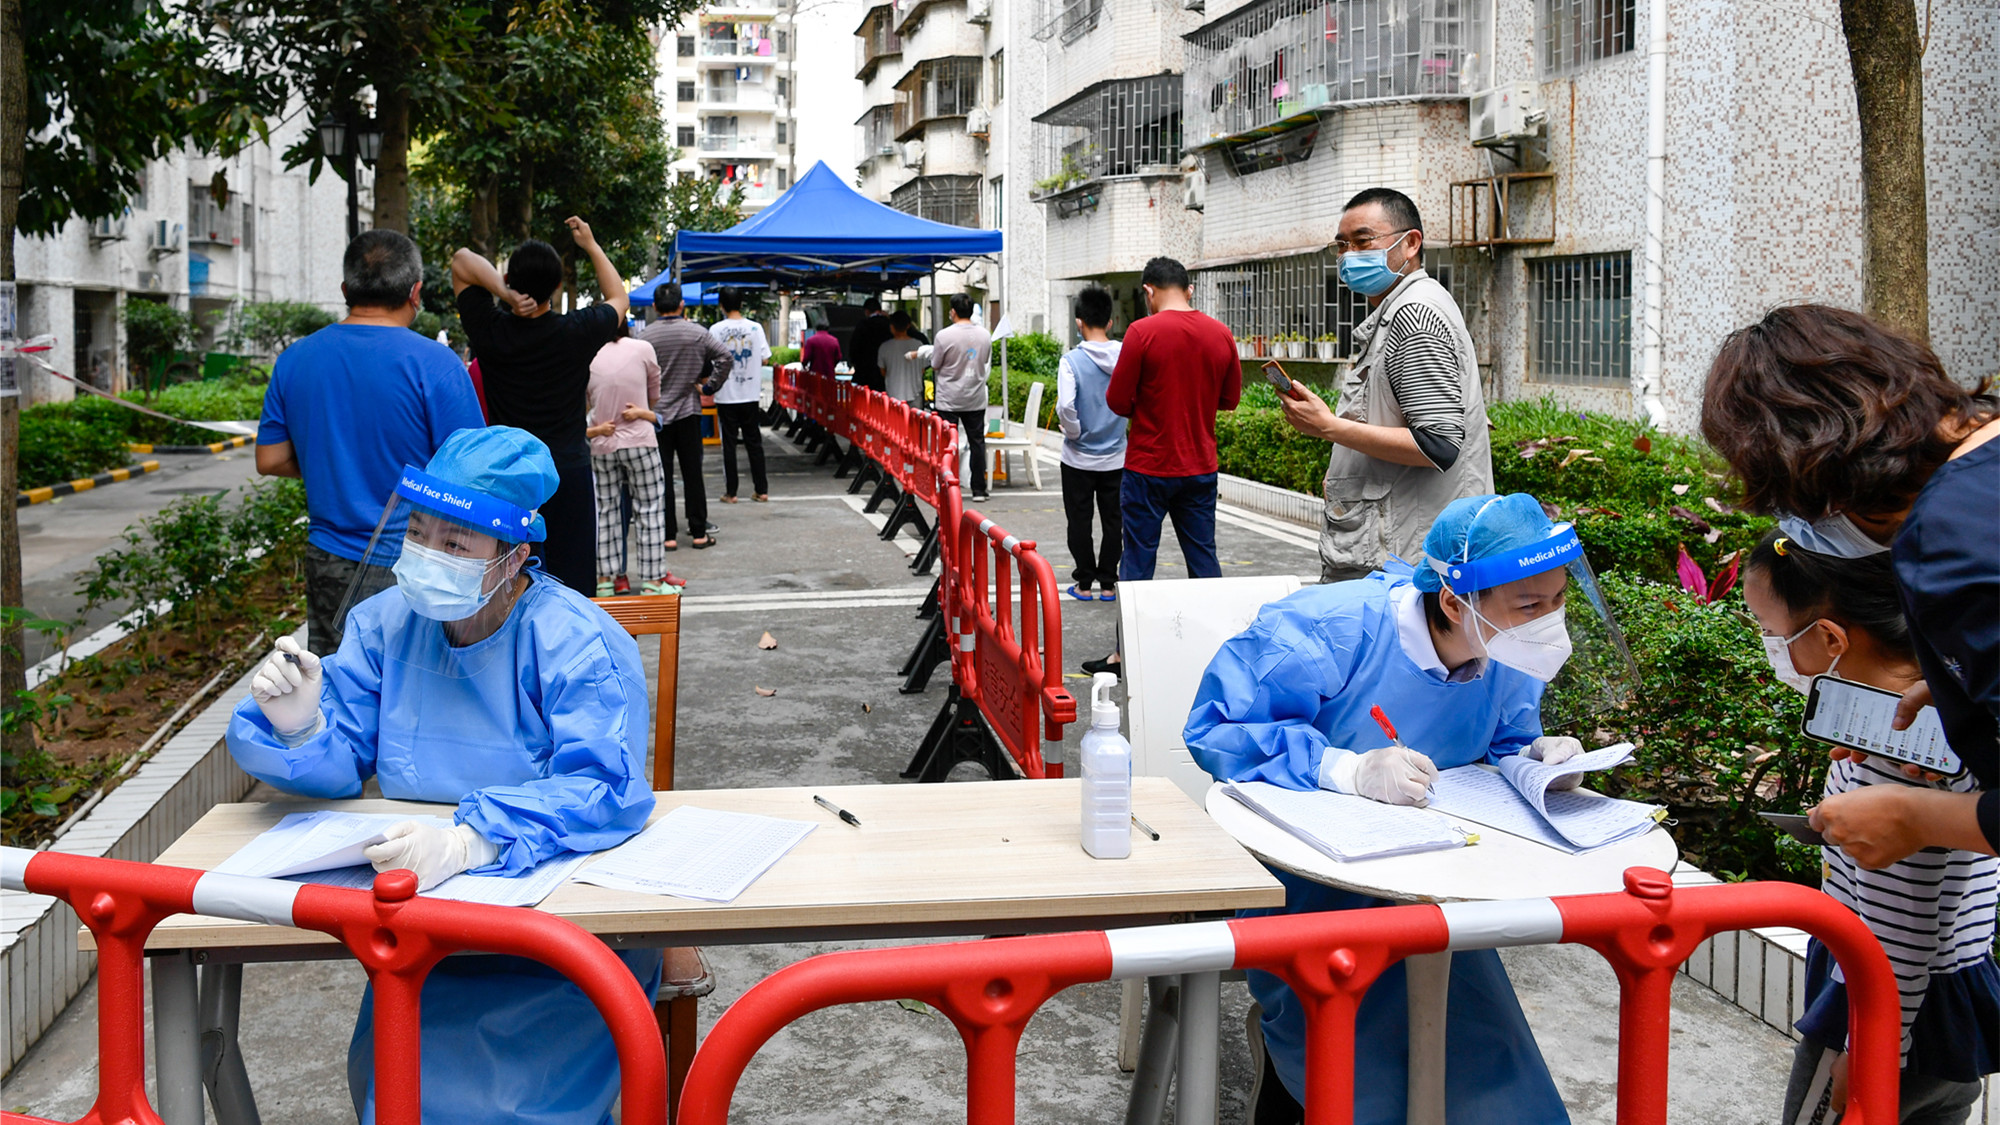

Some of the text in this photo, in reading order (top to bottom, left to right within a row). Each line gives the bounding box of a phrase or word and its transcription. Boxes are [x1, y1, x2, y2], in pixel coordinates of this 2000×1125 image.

[401, 477, 472, 510] Medical Face Shield
[1518, 548, 1555, 567] Medical
[1556, 543, 1571, 555] Face
